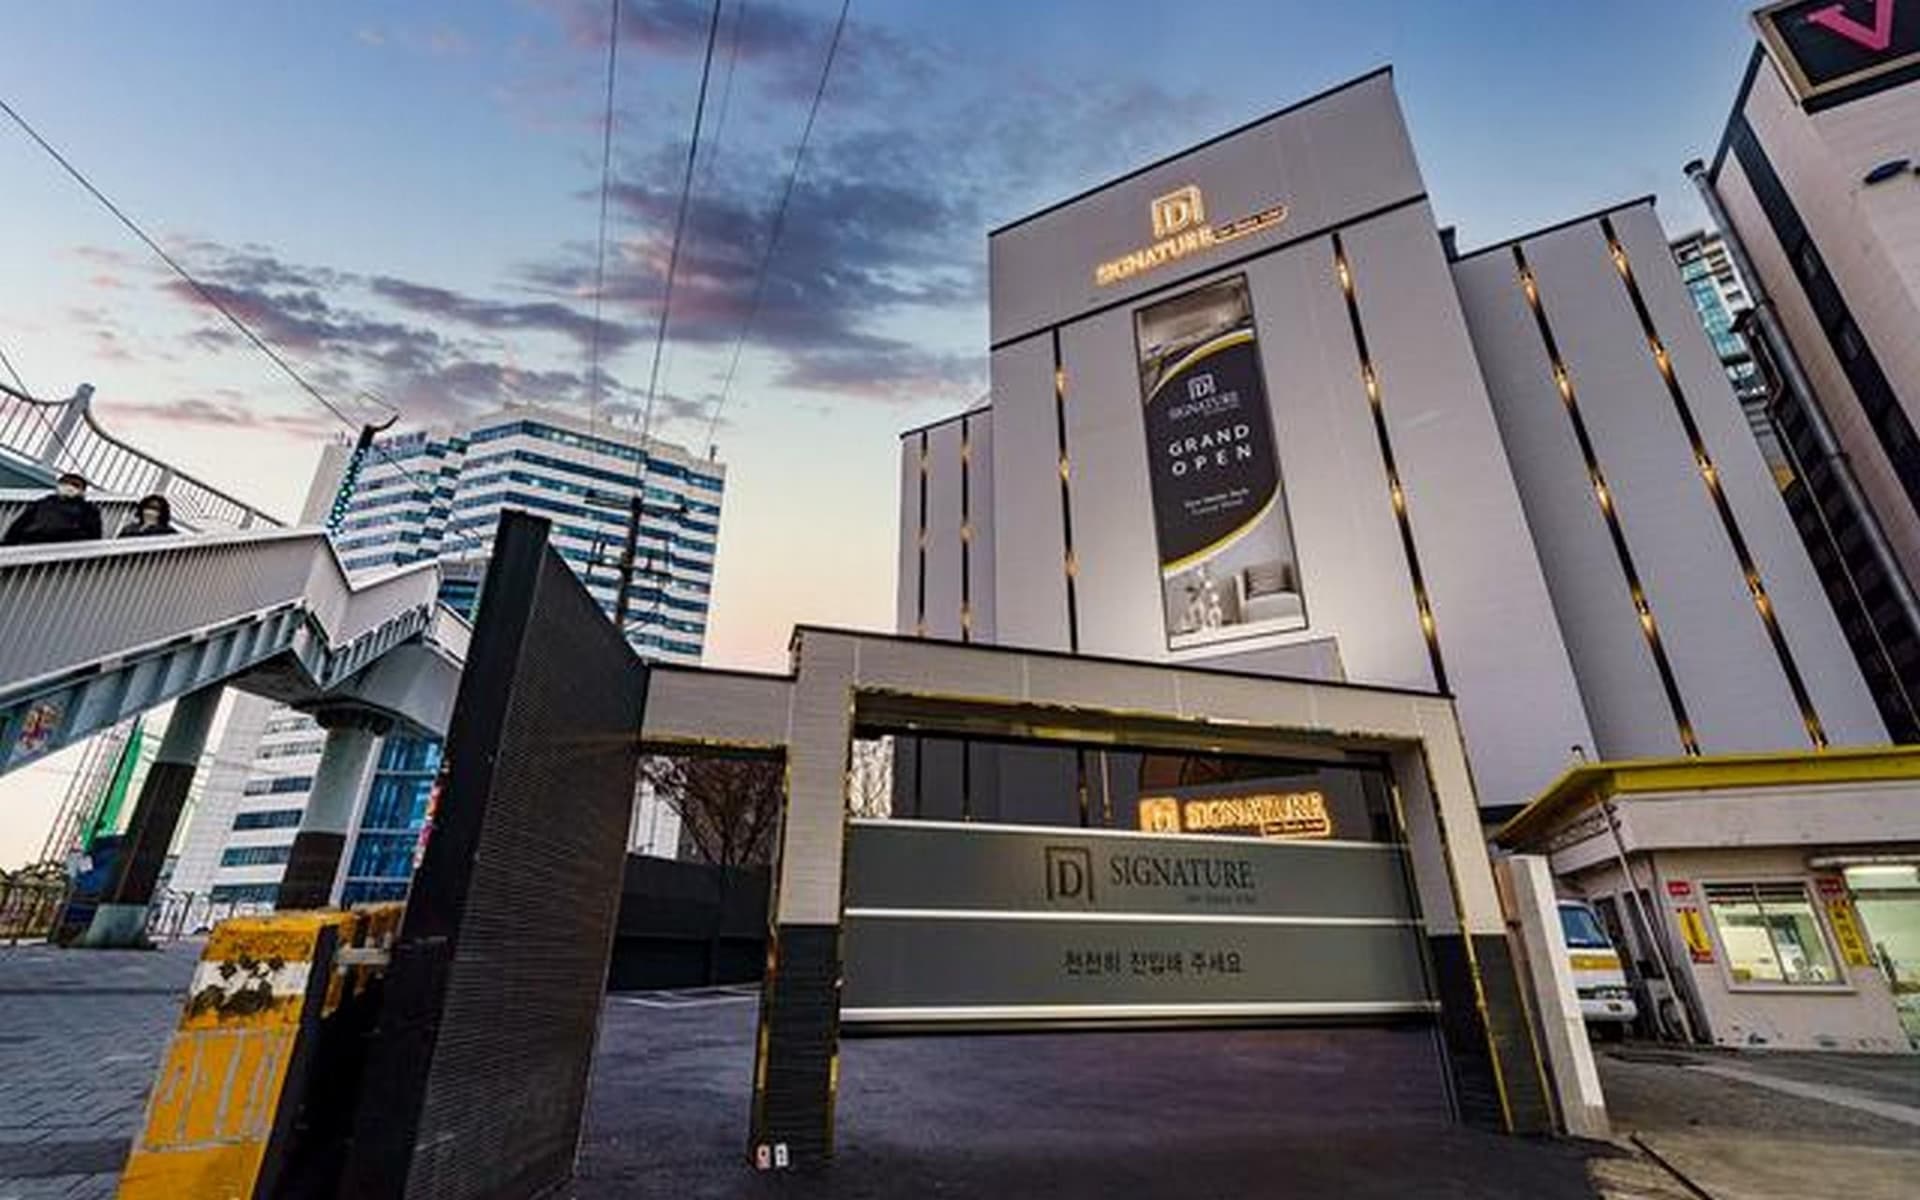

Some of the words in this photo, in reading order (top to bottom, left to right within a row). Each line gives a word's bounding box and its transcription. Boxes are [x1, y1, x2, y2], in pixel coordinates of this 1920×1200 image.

[1096, 227, 1214, 286] SIGNATURE
[1169, 424, 1249, 457] GRAND
[1172, 444, 1252, 476] OPEN
[1109, 856, 1256, 890] SIGNATURE
[1062, 951, 1121, 975] 천천히
[1190, 952, 1242, 975] 주세요
